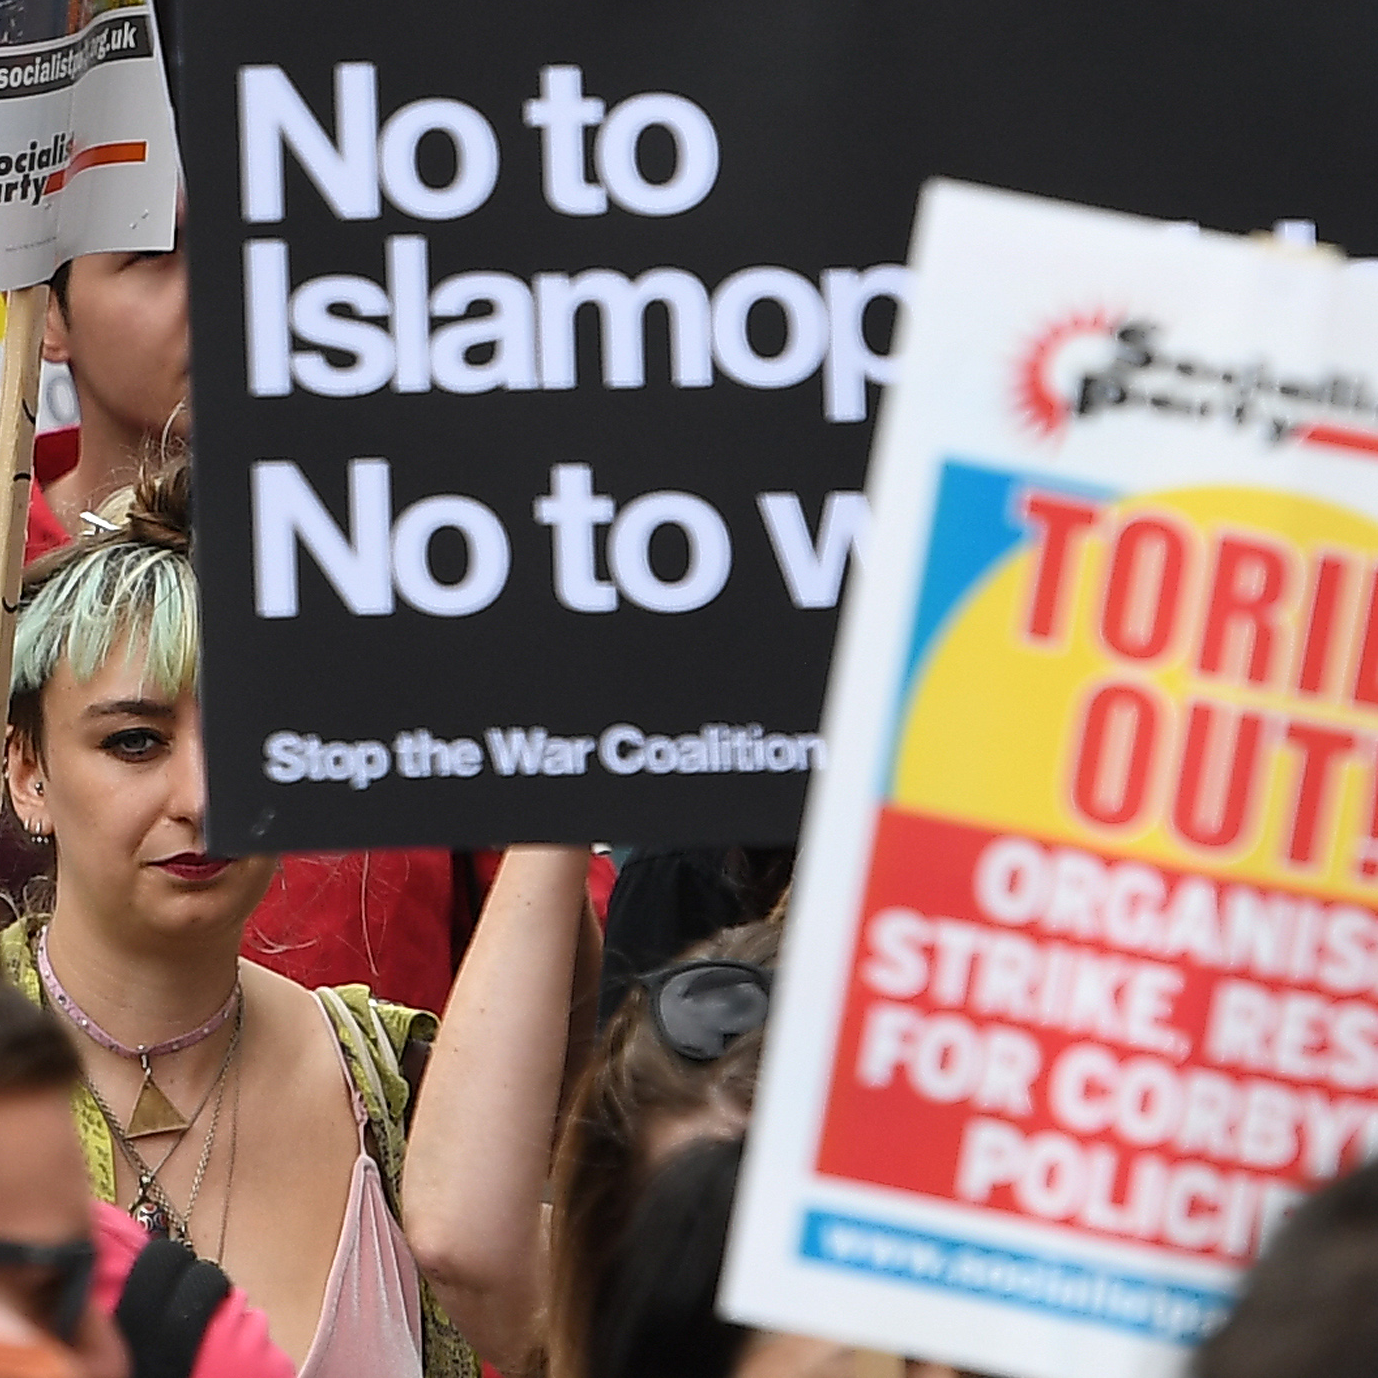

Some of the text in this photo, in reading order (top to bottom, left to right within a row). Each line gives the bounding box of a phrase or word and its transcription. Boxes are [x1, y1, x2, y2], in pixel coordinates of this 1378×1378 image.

[237, 60, 722, 223] No to
[243, 233, 914, 422] Islamop
[251, 456, 513, 620] No
[533, 461, 733, 615] to
[263, 721, 829, 790] Stop the War Coalition
[854, 1002, 1378, 1184] FOR CORBY
